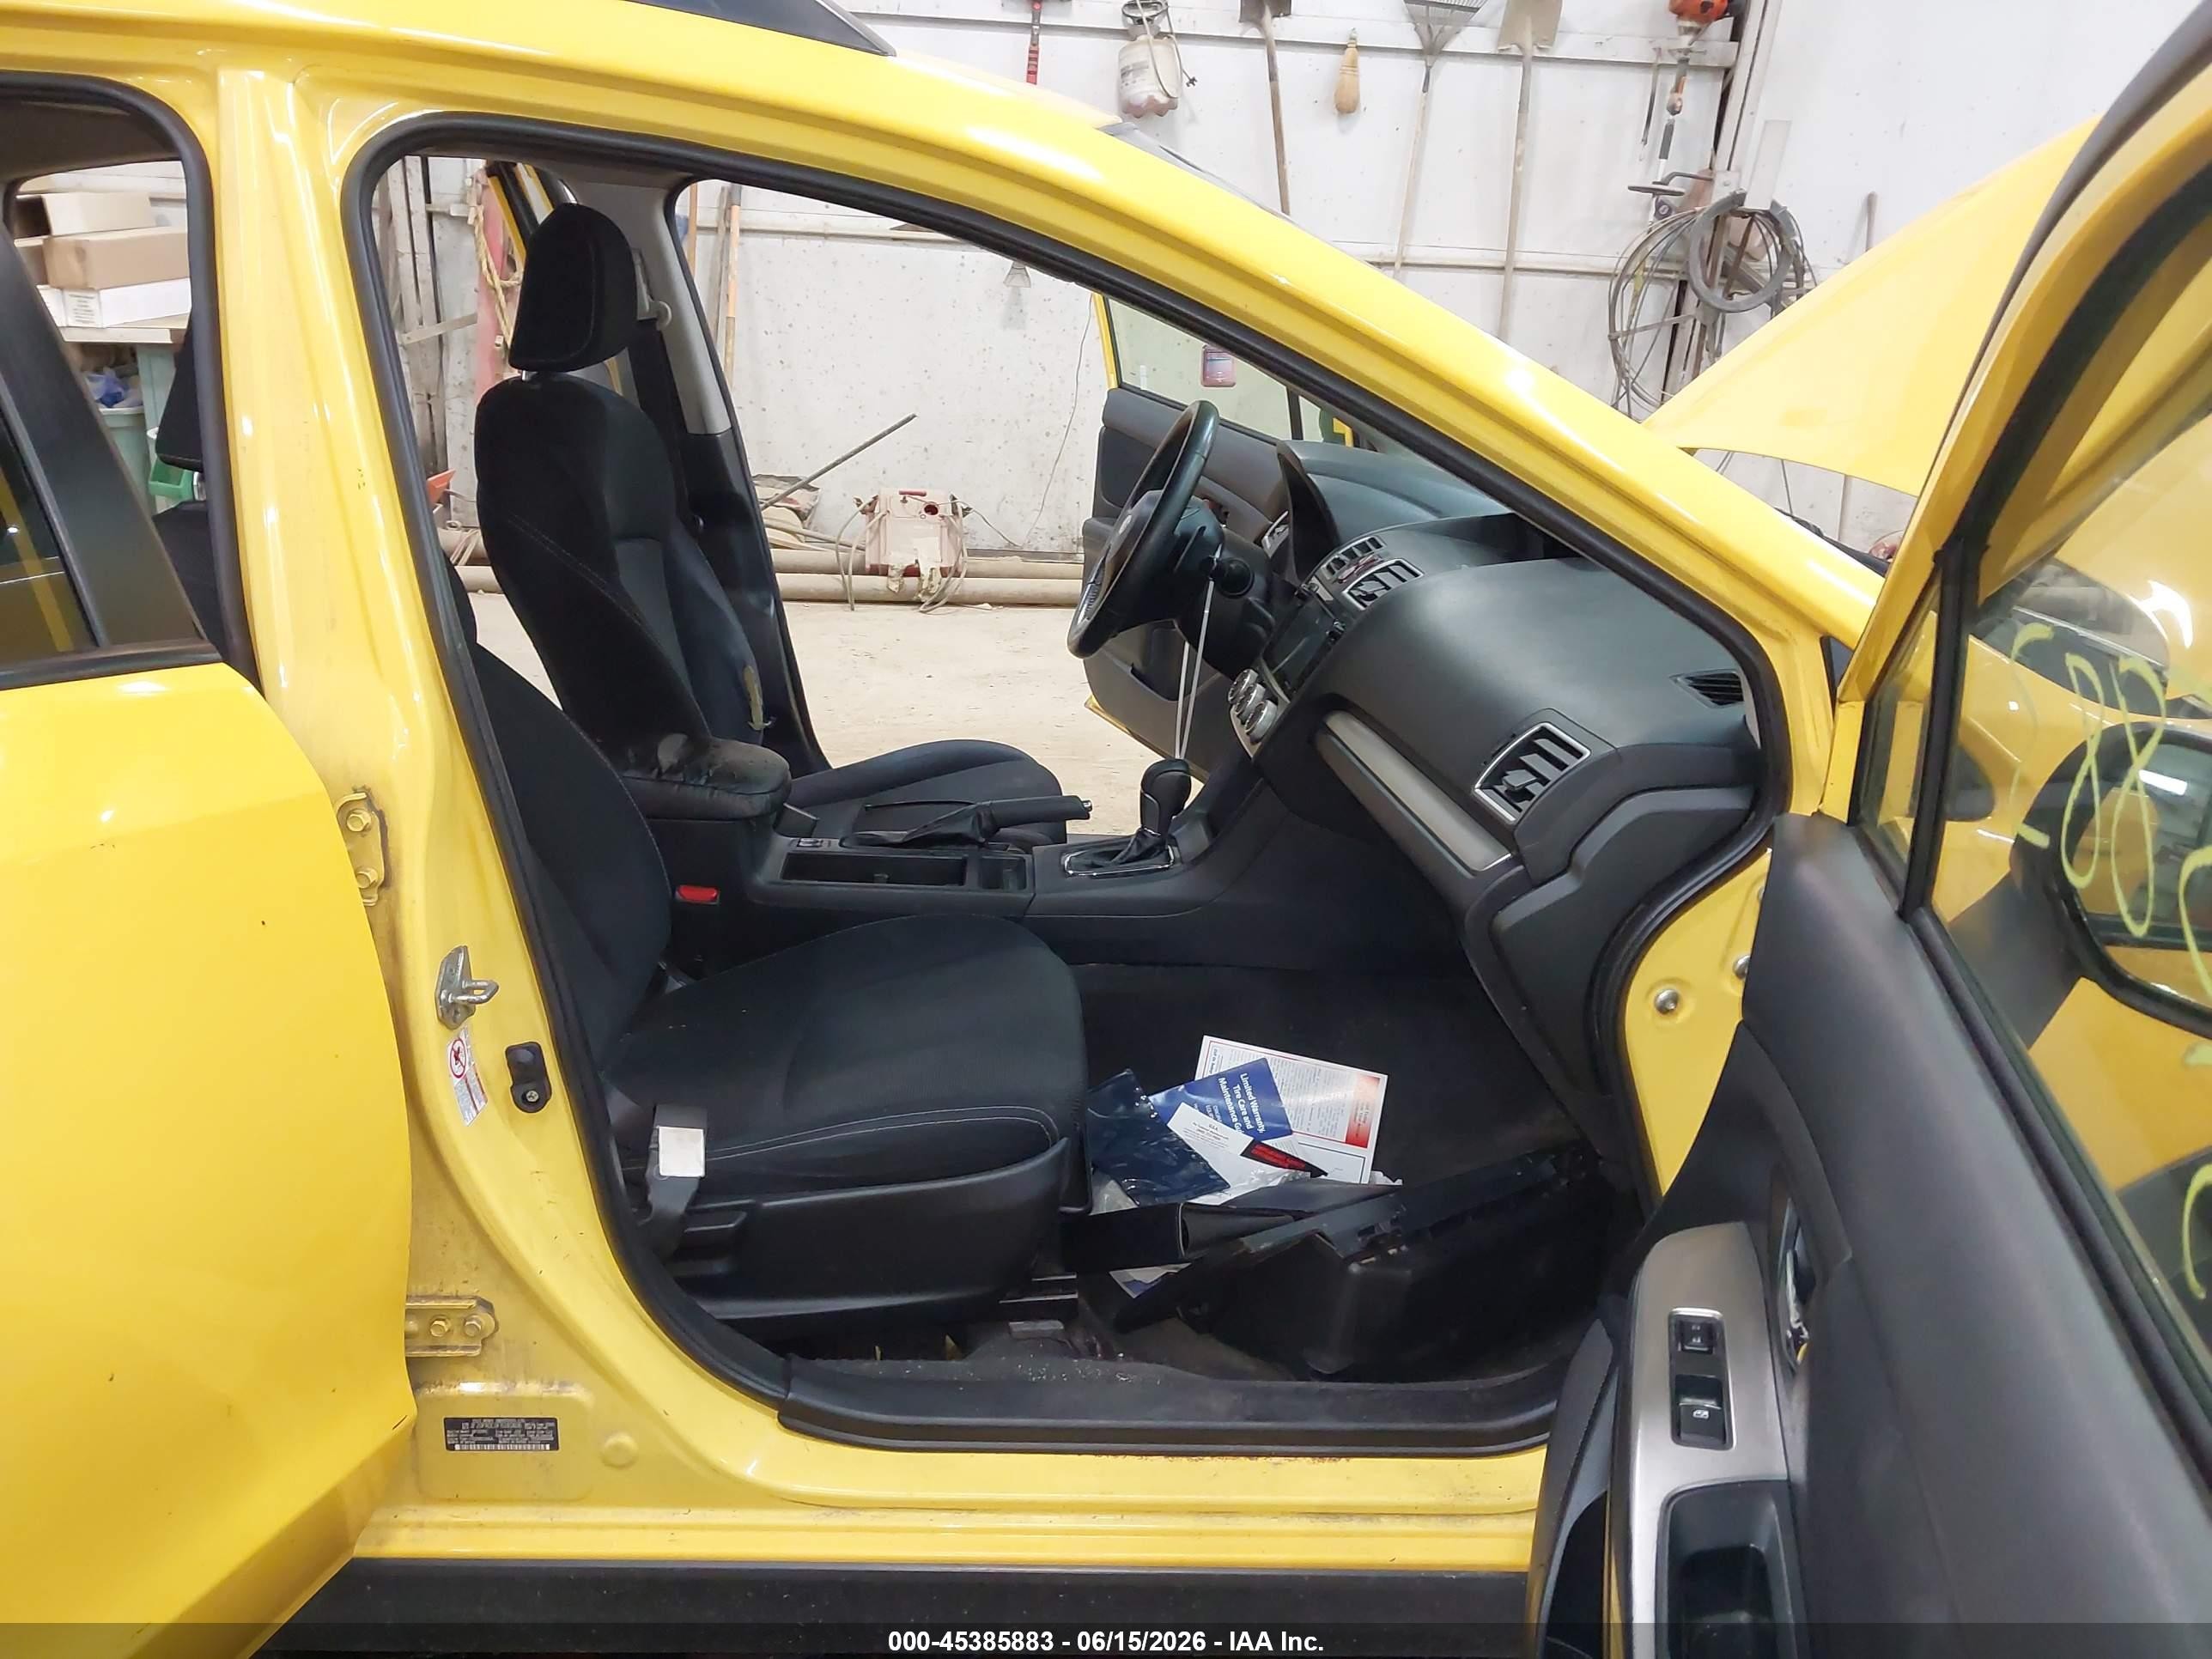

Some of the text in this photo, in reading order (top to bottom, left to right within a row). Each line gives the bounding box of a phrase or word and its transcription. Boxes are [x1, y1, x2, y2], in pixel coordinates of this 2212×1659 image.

[1218, 1077, 1238, 1123] Maintenance
[1233, 1084, 1255, 1130] Tire Care and
[1240, 1073, 1266, 1133] Limited Warranty,
